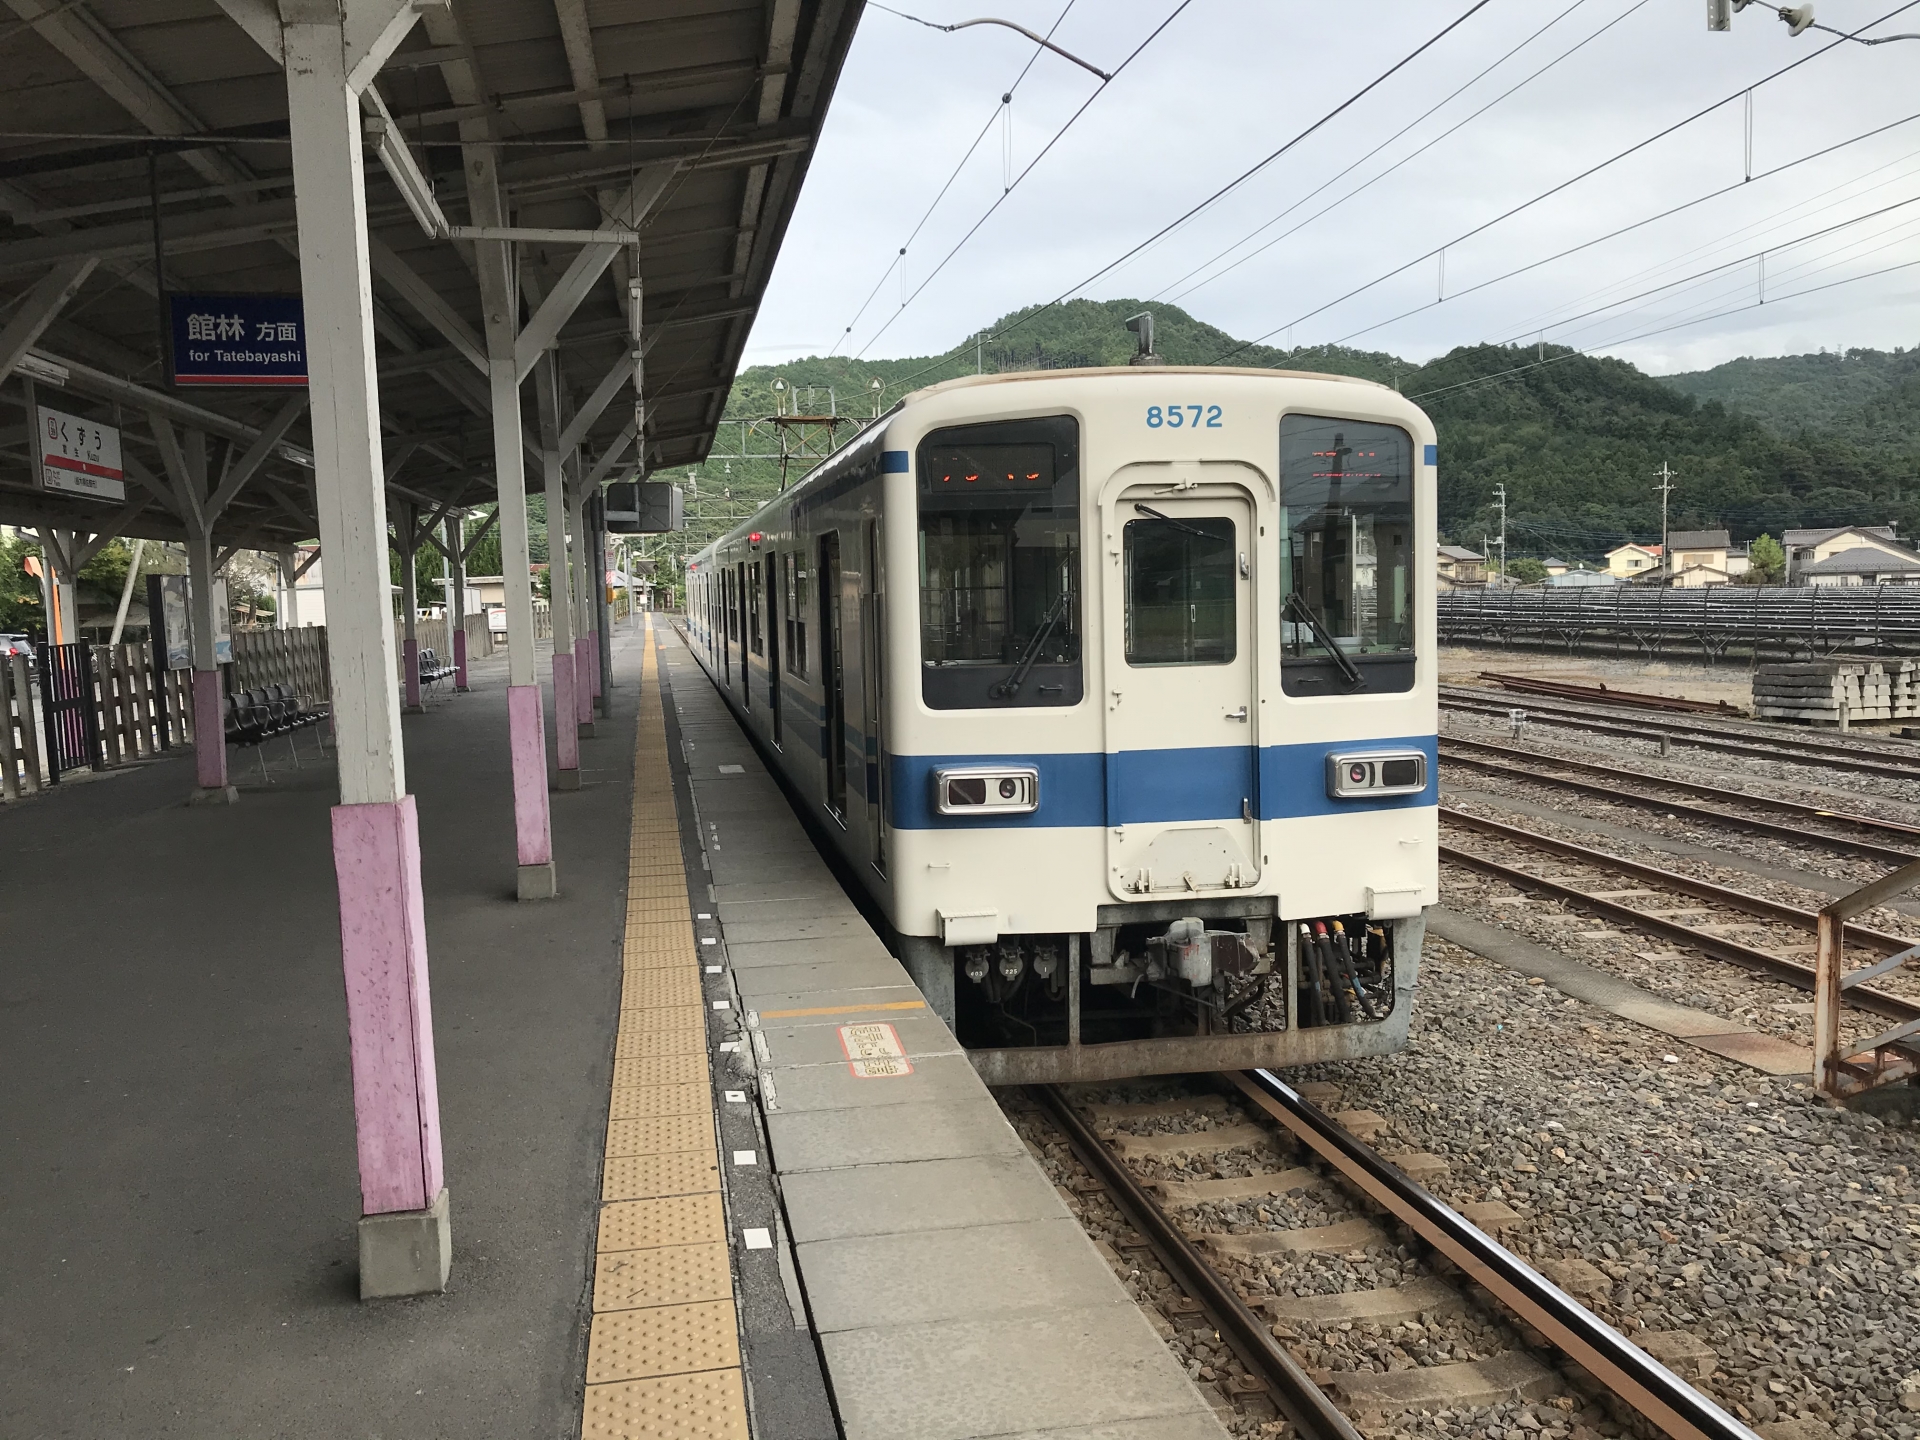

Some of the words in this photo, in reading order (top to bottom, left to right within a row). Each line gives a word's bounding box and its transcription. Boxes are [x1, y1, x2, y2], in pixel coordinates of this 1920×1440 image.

[187, 313, 245, 341] 館林
[256, 321, 297, 342] 方面
[189, 349, 210, 362] for
[214, 349, 301, 365] Tatebayashi
[1146, 404, 1223, 428] 8572
